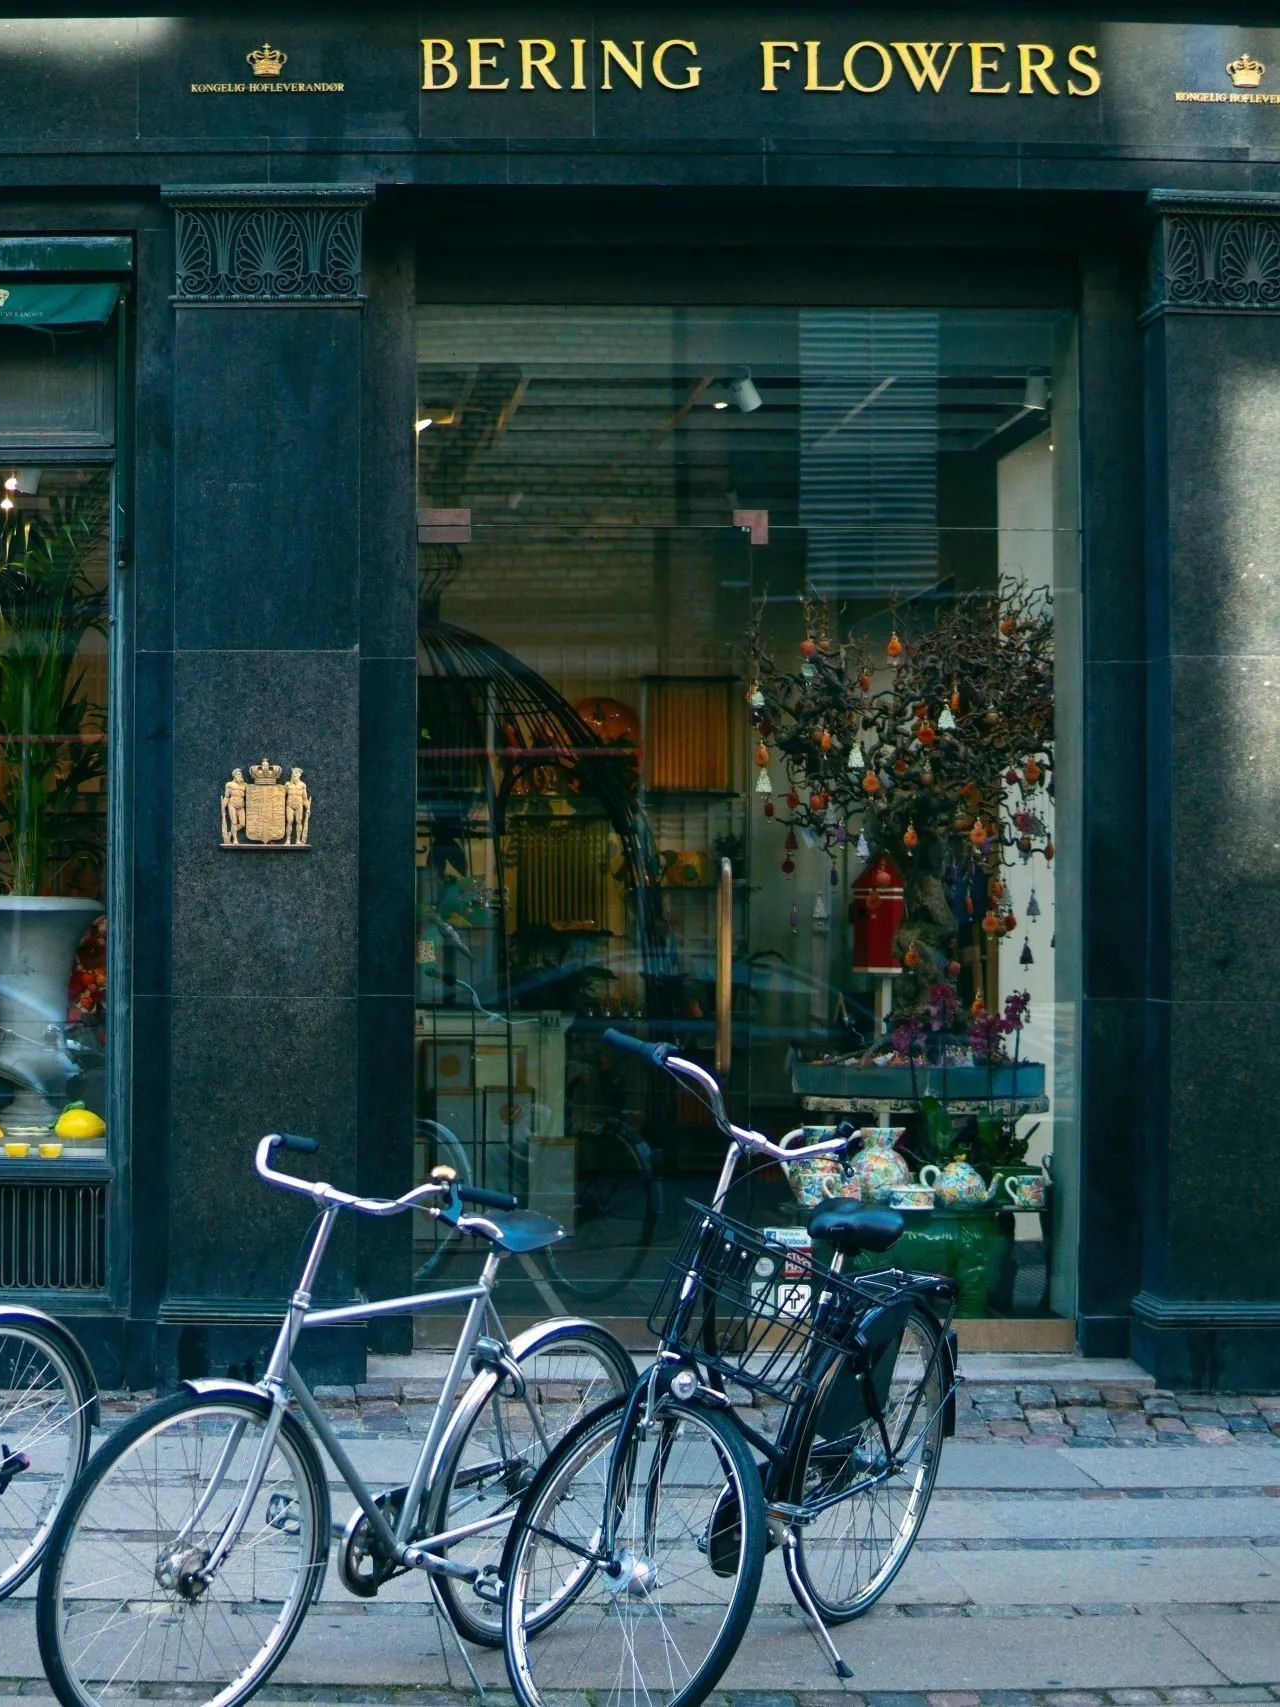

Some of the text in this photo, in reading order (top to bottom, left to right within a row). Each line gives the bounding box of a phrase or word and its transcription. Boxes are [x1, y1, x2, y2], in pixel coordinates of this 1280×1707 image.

[420, 38, 1103, 96] BERING FLOWERS
[191, 82, 345, 93] KONGELIG HOFLEVERANDØR
[1175, 92, 1227, 102] KONGELIG
